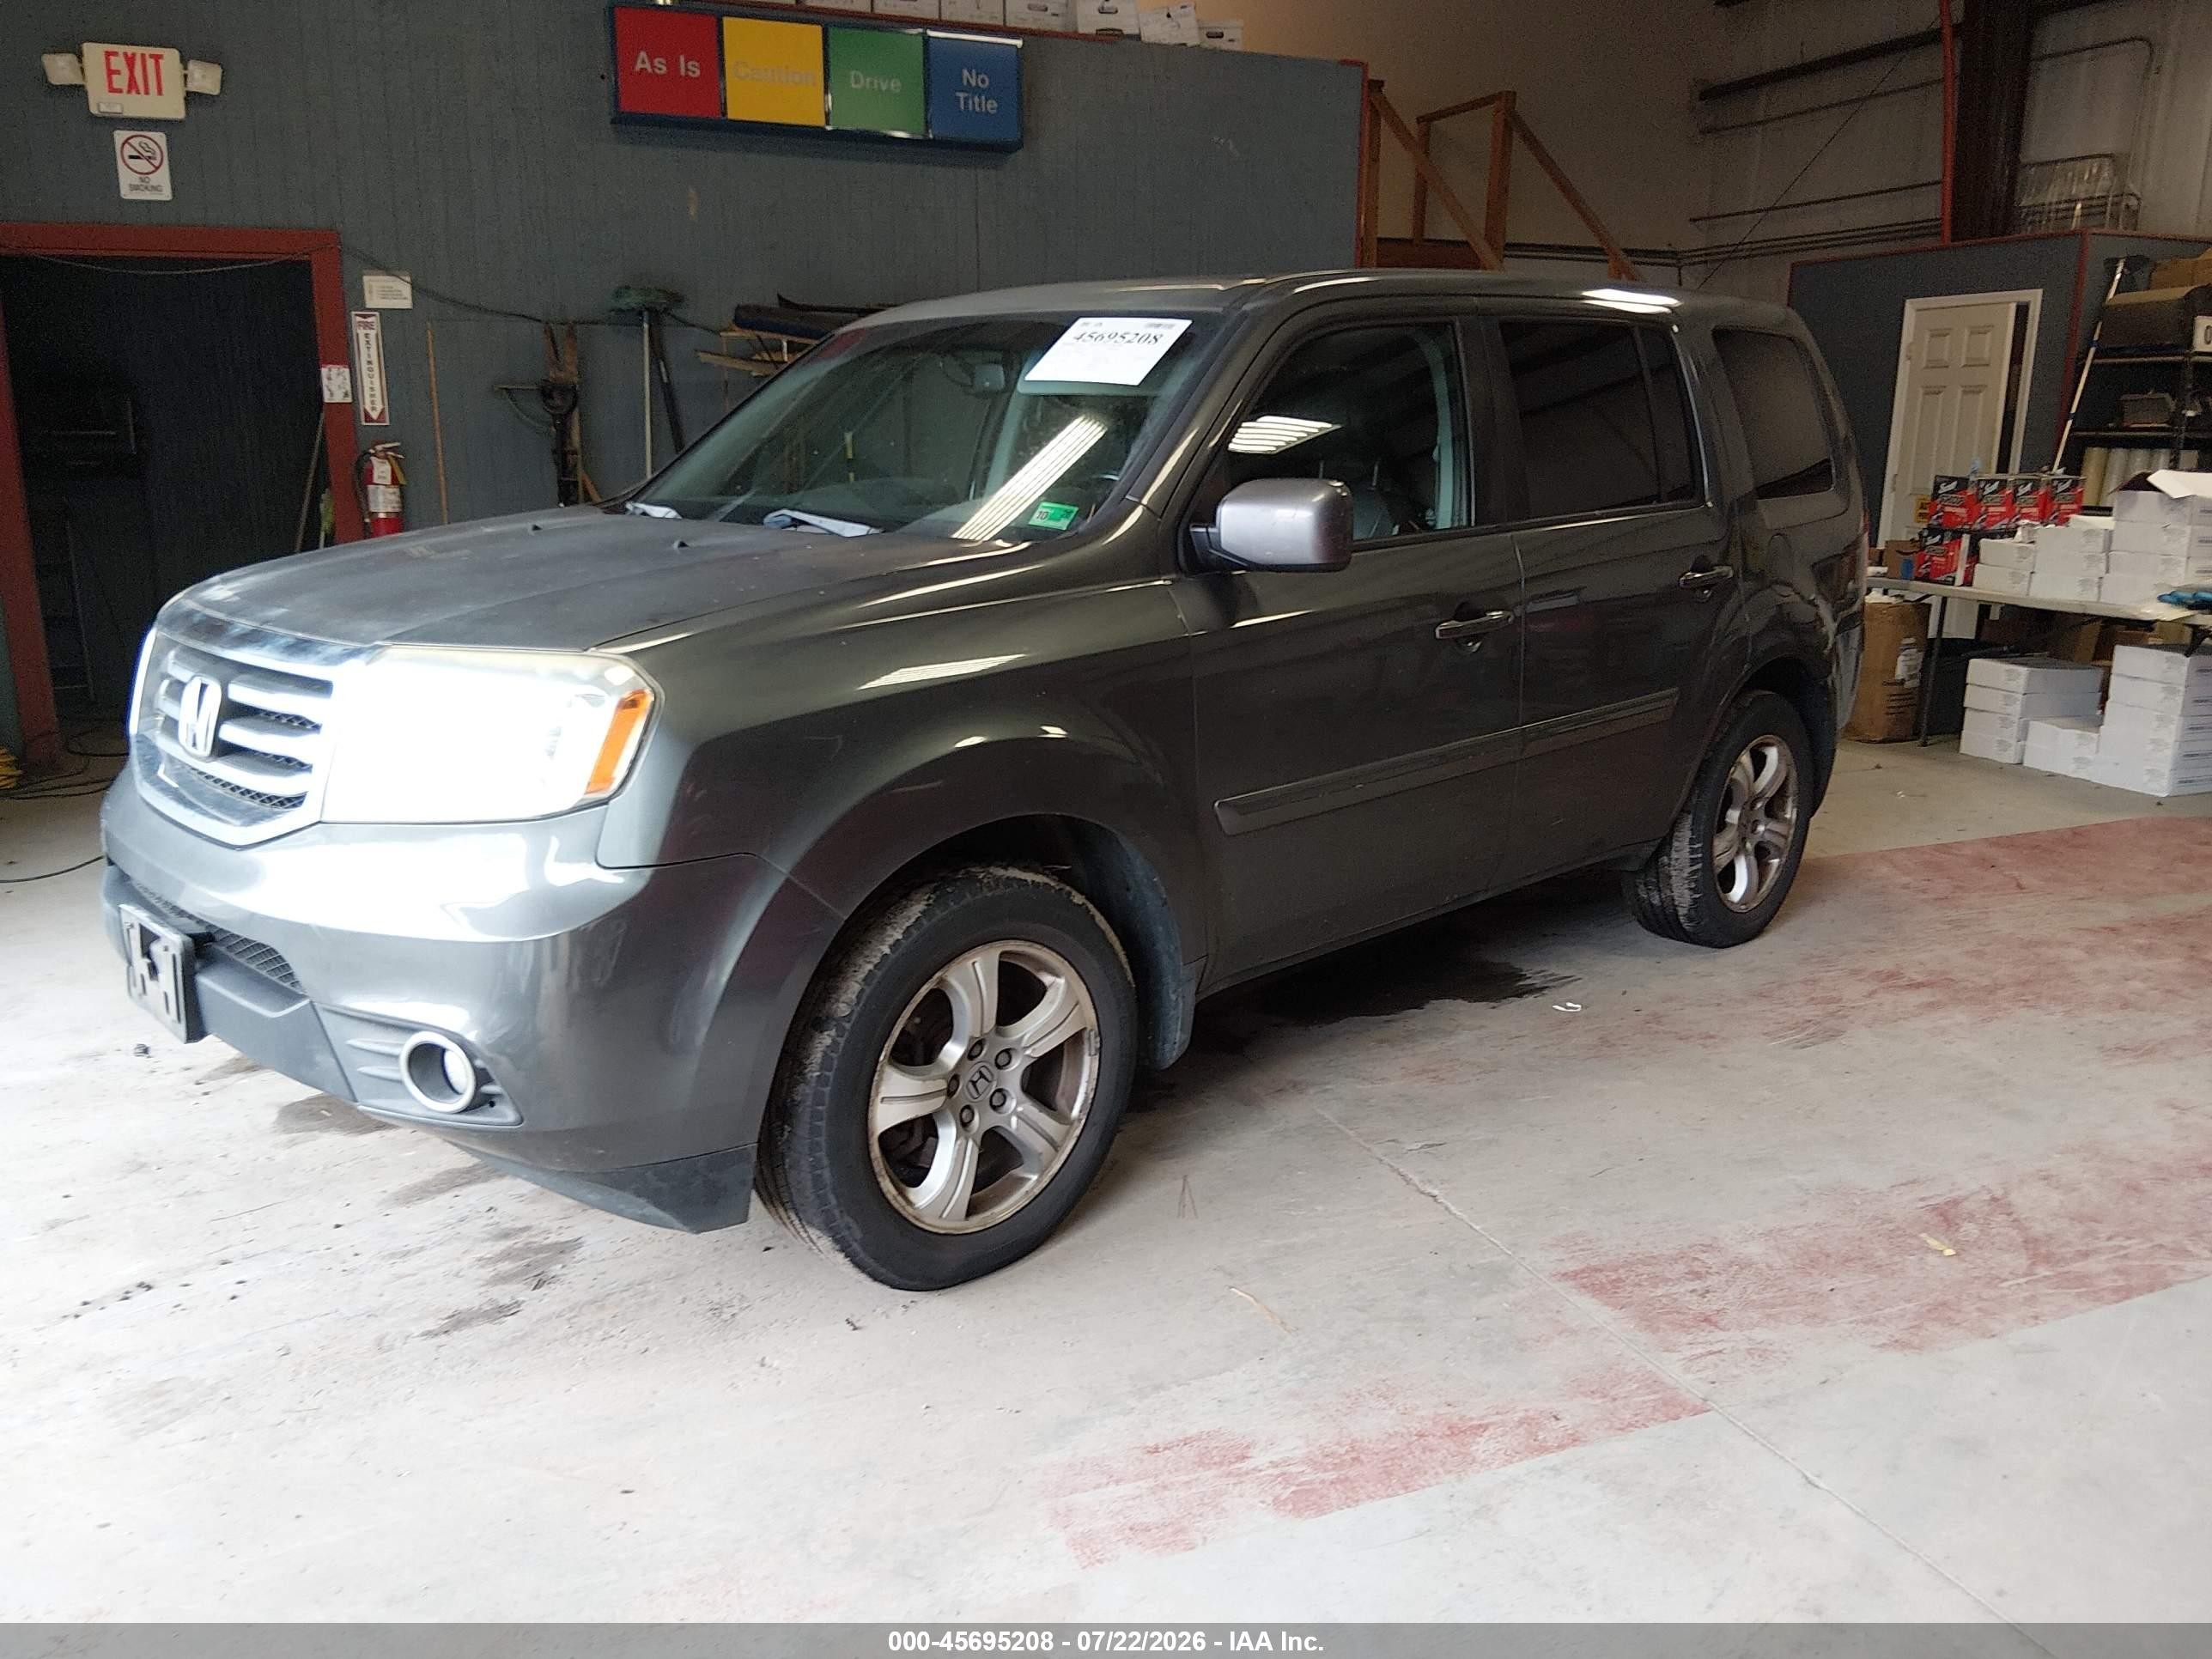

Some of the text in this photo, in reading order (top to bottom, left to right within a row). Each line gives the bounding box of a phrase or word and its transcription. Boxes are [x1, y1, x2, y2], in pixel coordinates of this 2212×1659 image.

[104, 50, 164, 96] EXIT
[635, 51, 701, 77] As Is
[850, 70, 901, 93] Drive
[962, 68, 989, 88] No
[955, 91, 998, 115] Title
[1073, 331, 1164, 345] 45695208
